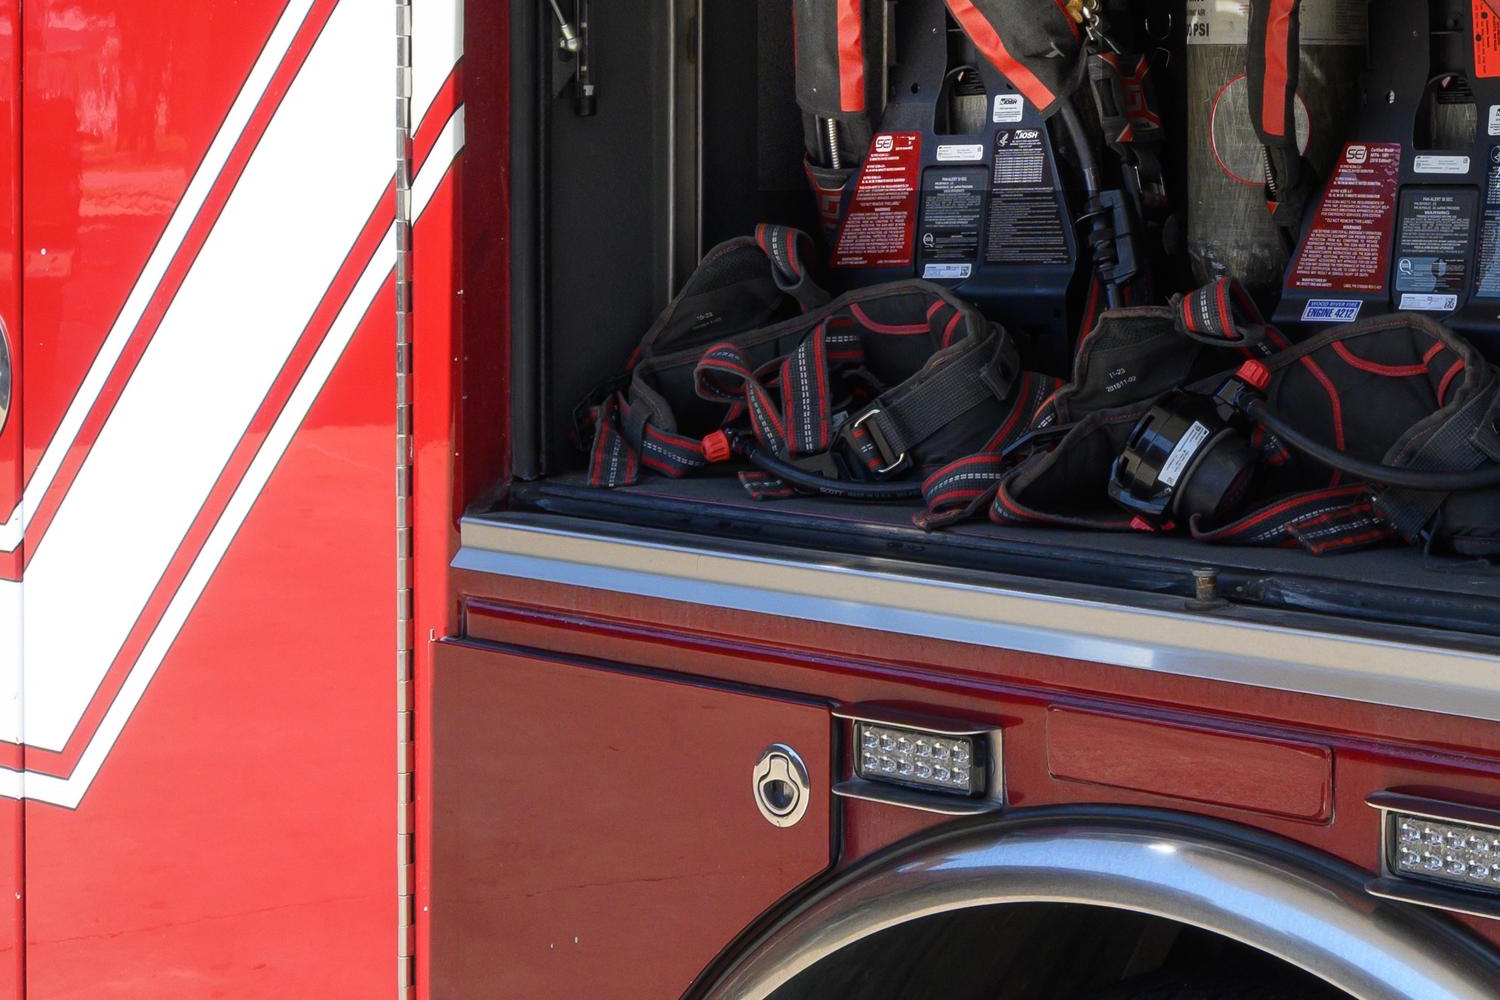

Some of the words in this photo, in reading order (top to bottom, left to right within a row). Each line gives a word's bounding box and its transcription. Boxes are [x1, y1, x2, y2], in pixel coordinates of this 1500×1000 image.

[1193, 22, 1210, 37] PSI
[1013, 129, 1039, 140] NIOSH
[1347, 149, 1367, 160] SEI
[1307, 308, 1334, 318] ENGINE
[1335, 308, 1355, 319] 4212
